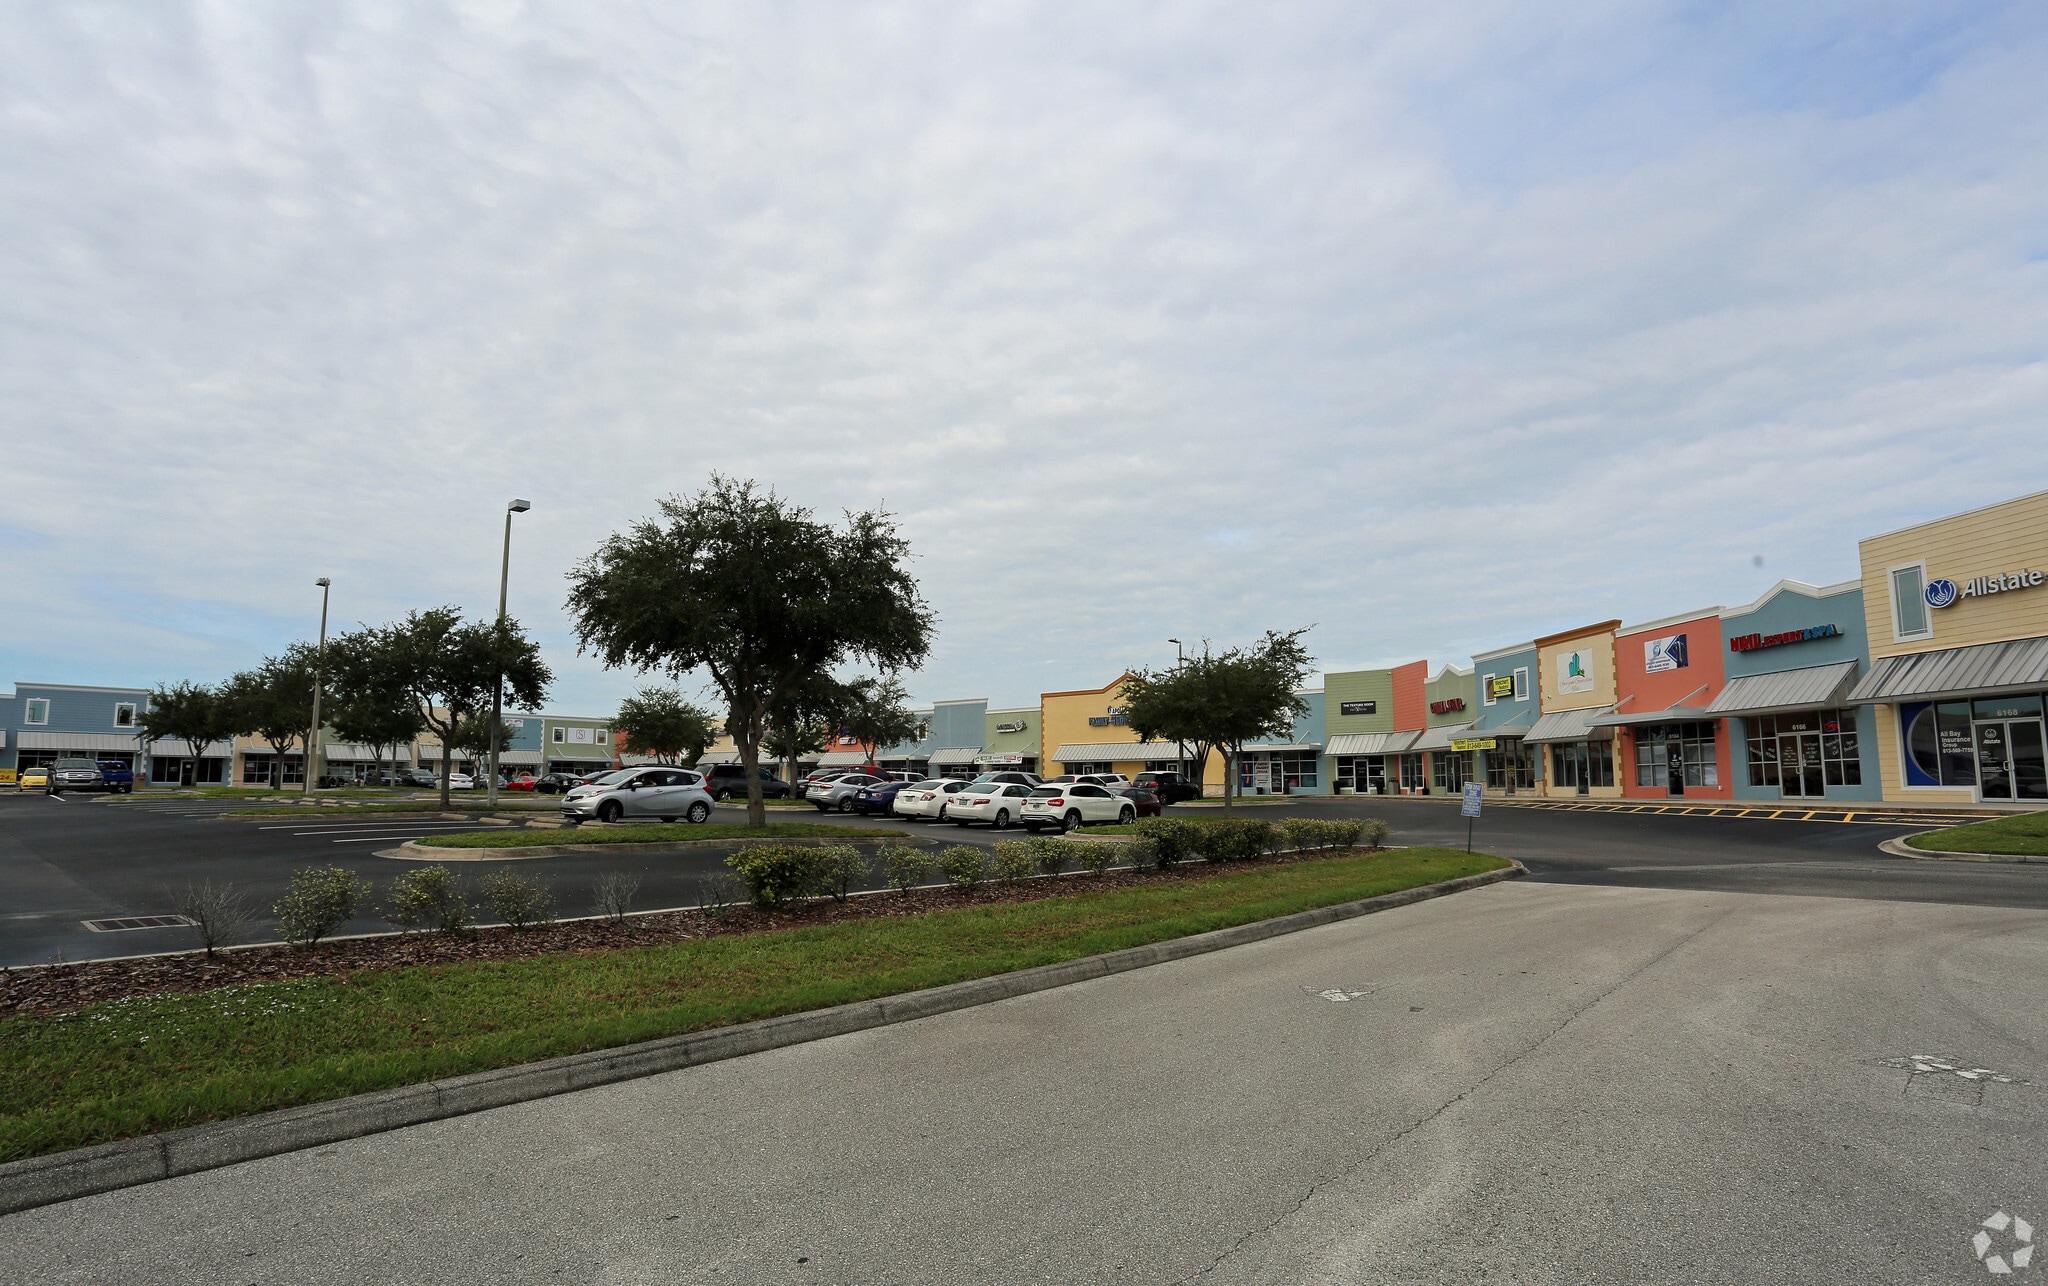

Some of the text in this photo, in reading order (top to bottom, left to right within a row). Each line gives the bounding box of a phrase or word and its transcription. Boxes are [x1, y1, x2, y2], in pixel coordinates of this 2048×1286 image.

[1961, 568, 2045, 599] Allstate
[1730, 633, 1762, 652] NAIL
[1996, 709, 2018, 717] 6168
